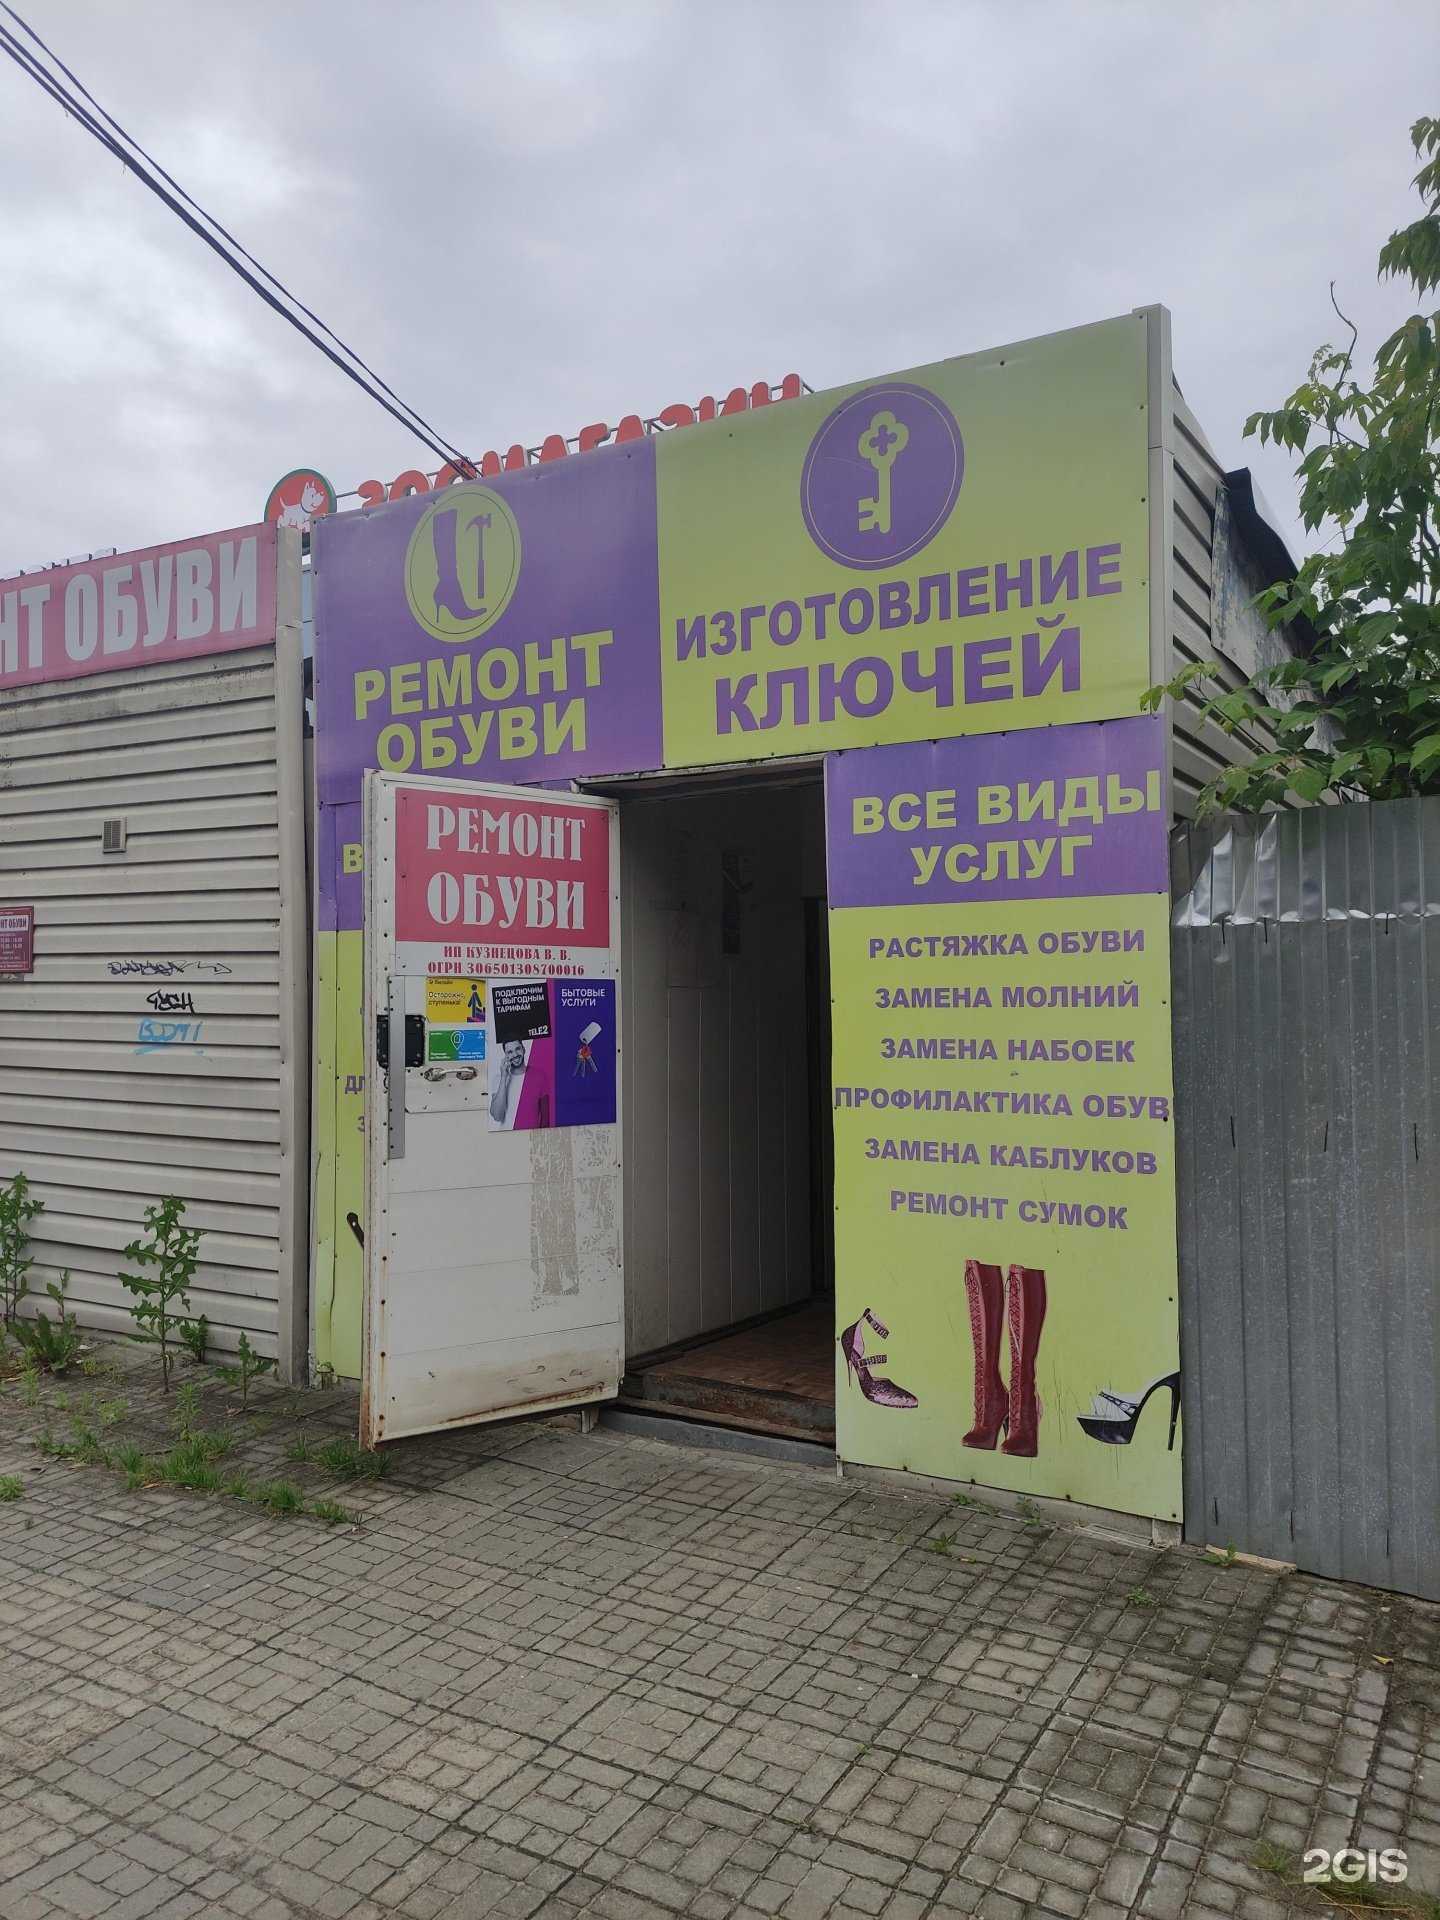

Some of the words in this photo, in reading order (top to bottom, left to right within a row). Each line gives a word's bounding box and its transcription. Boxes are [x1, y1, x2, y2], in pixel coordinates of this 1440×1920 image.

[65, 536, 257, 662] ОБУВИ
[676, 543, 1122, 661] ИЗГОТОВЛЕНИЕ
[353, 630, 614, 720] РЕМОНТ
[715, 613, 1081, 735] КЛЮЧЕЙ
[376, 698, 587, 773] ОБУВИ
[852, 789, 957, 834] ВСЕ
[977, 770, 1161, 827] ВИДЫ
[426, 804, 586, 861] РЕМОНТ
[911, 834, 1093, 886] УСЛУГ
[427, 871, 585, 930] ОБУВИ
[444, 946, 462, 958] ИП
[466, 947, 540, 961] КУЗНЕЦОВА
[869, 933, 1029, 958] РАСТЯЖКА
[1038, 929, 1145, 955] ОБУВИ
[428, 962, 462, 974] ОГРН
[495, 986, 543, 998] ПОДКЛЮЧИМ
[502, 994, 545, 1005] ВЫГОДНЫМ
[561, 988, 606, 998] БЫТОВЫЕ
[561, 998, 597, 1008] УСЛУГИ
[875, 986, 993, 1009] ЗАМЕНА
[1002, 980, 1140, 1008] МОЛНИЙ
[496, 1004, 531, 1014] ТАРИФАМ
[528, 1025, 549, 1036] TELE2
[880, 1038, 998, 1060] ЗАМЕНА
[1008, 1039, 1135, 1062] НАБОЕК
[834, 1088, 1073, 1117] ПРОФИЛАКТИКА
[865, 1138, 981, 1165] ЗАМЕНА
[990, 1145, 1158, 1175] КАБЛУКОВ
[890, 1190, 1009, 1220] РЕМОНТ
[1019, 1201, 1129, 1230] СУМОК
